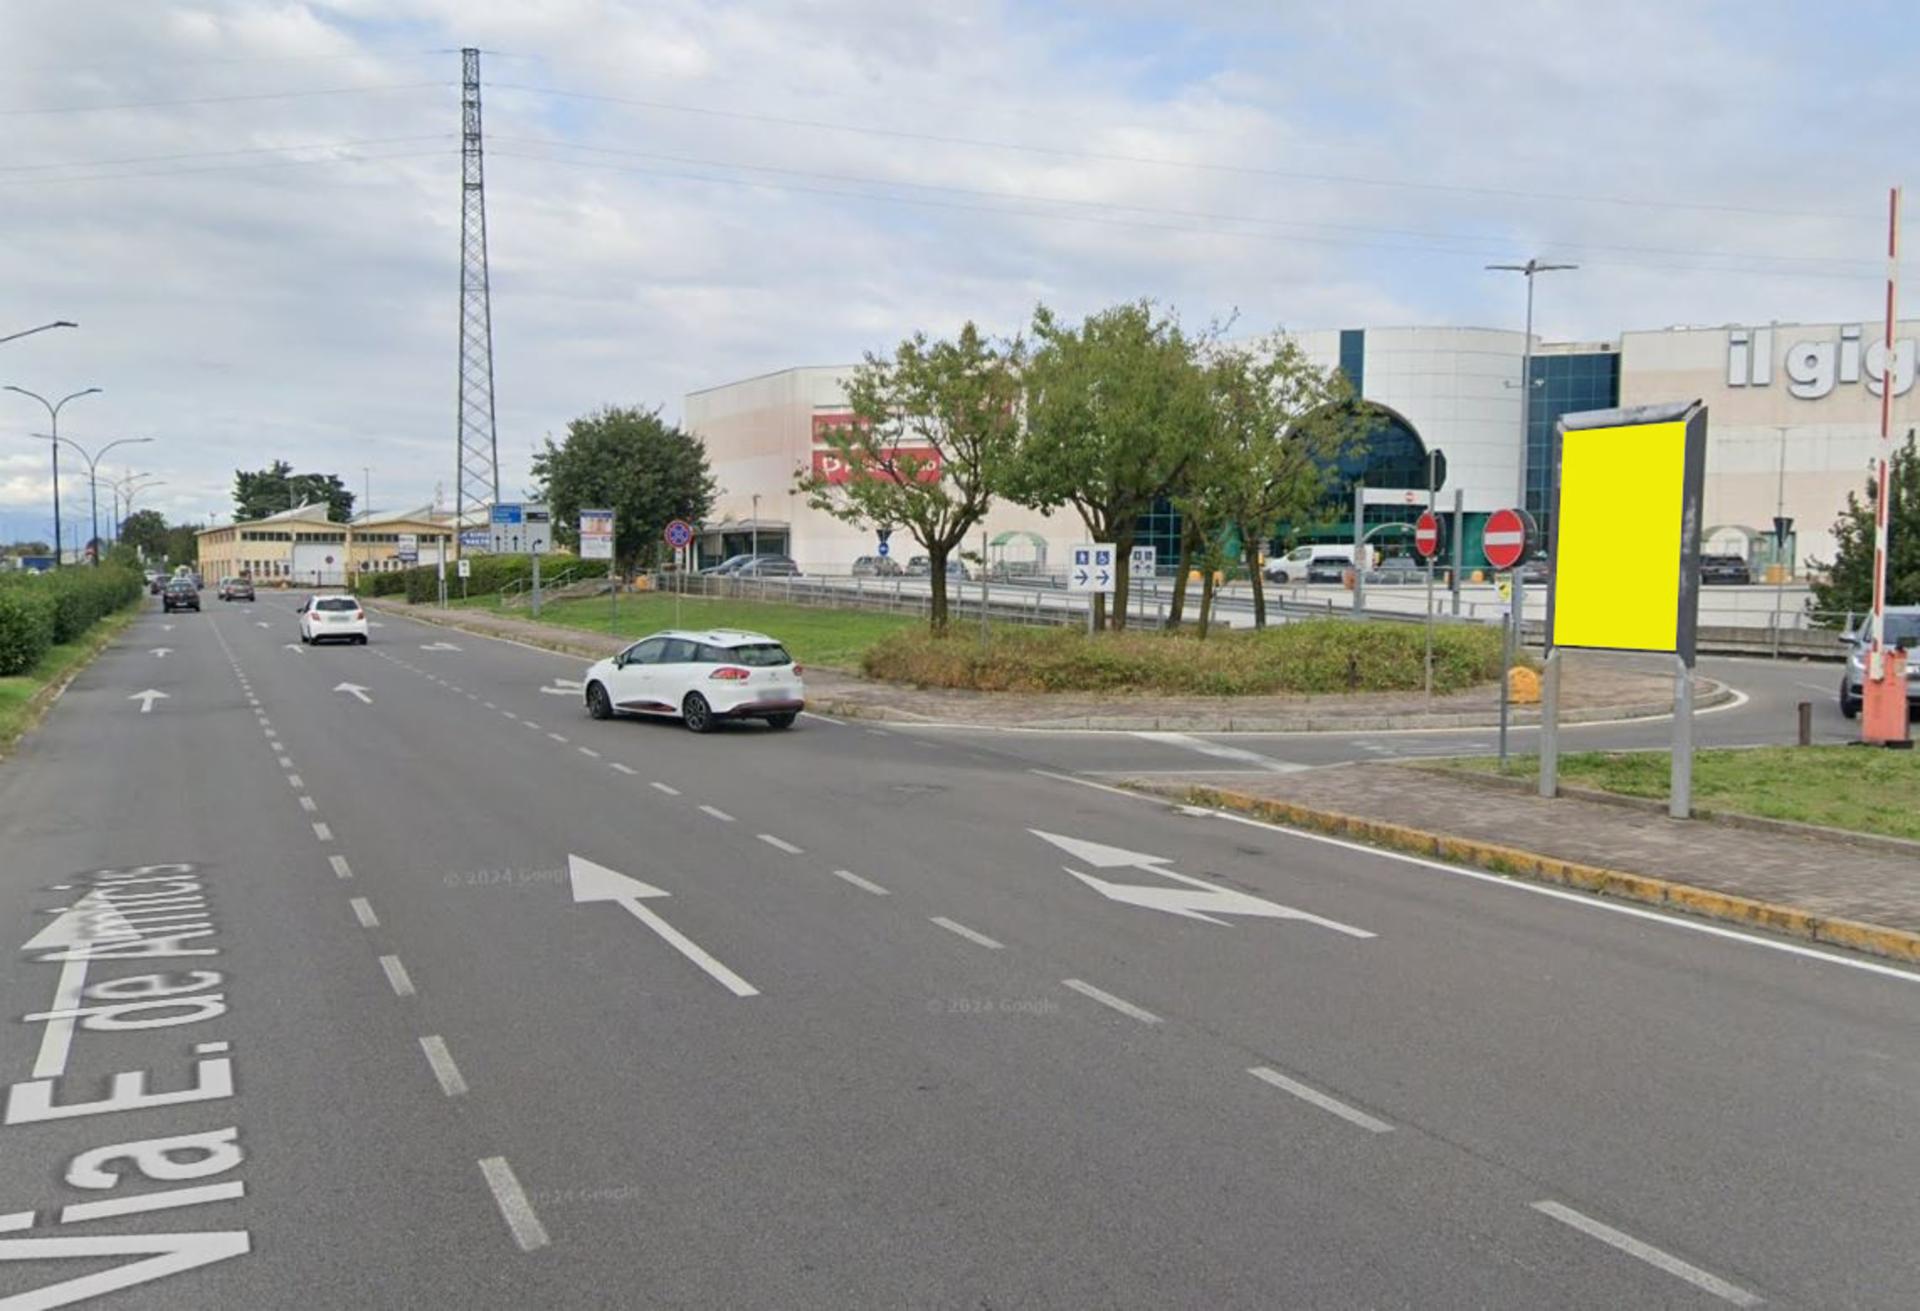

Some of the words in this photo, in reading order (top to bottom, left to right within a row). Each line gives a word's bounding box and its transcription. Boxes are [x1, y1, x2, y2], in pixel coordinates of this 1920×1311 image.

[1727, 327, 1774, 388] il
[1785, 323, 1920, 401] gig
[31, 863, 219, 962] Amicis
[23, 971, 227, 1031] de
[5, 1041, 234, 1125] E.
[0, 1126, 250, 1311] Via
